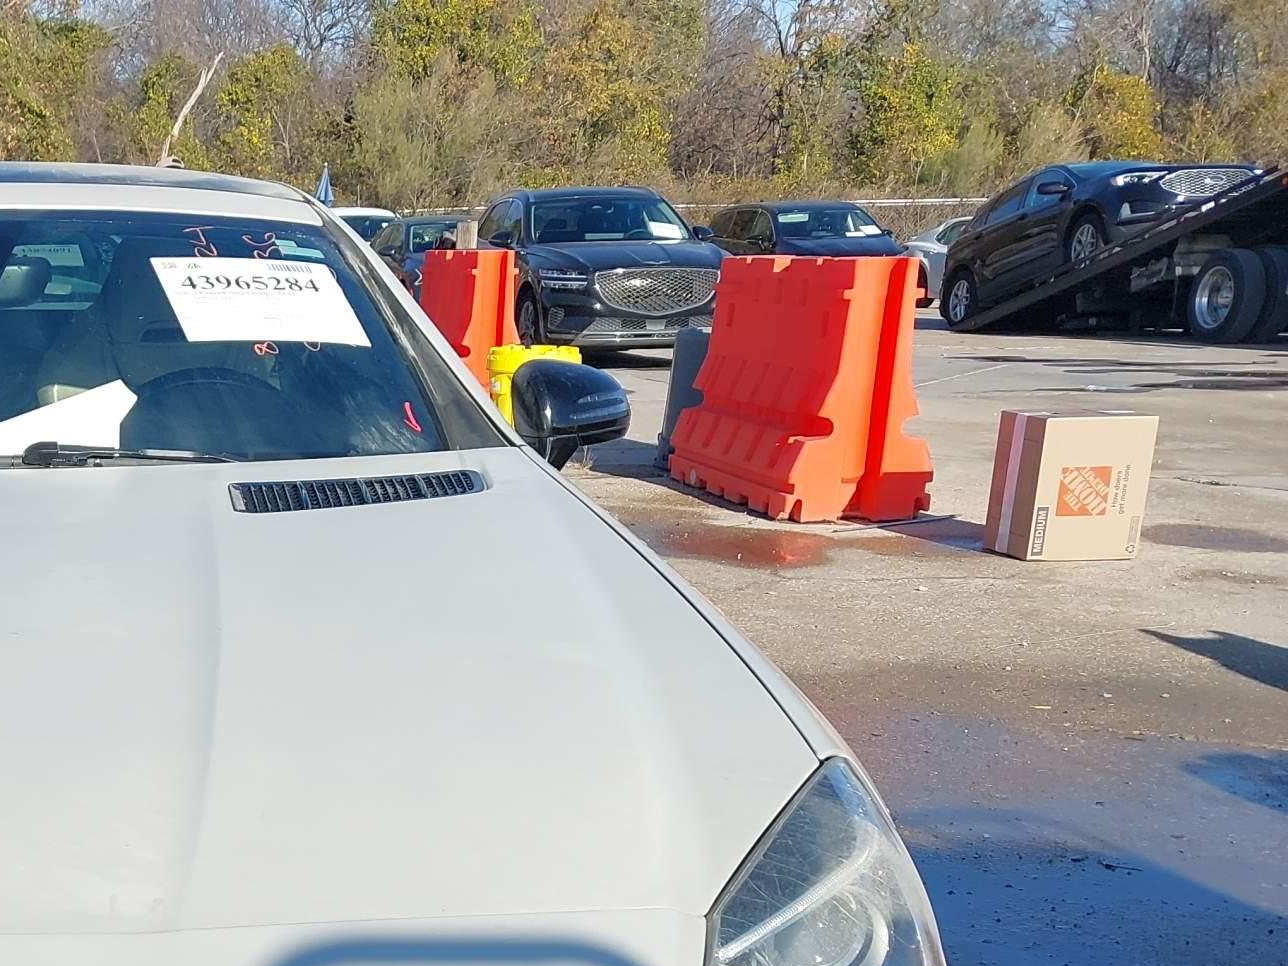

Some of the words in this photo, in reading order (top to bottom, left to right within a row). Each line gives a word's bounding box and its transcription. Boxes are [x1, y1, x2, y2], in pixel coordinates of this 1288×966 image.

[181, 275, 321, 293] 43965284
[1062, 467, 1107, 516] HOME
[1033, 511, 1047, 552] MEDIUM
